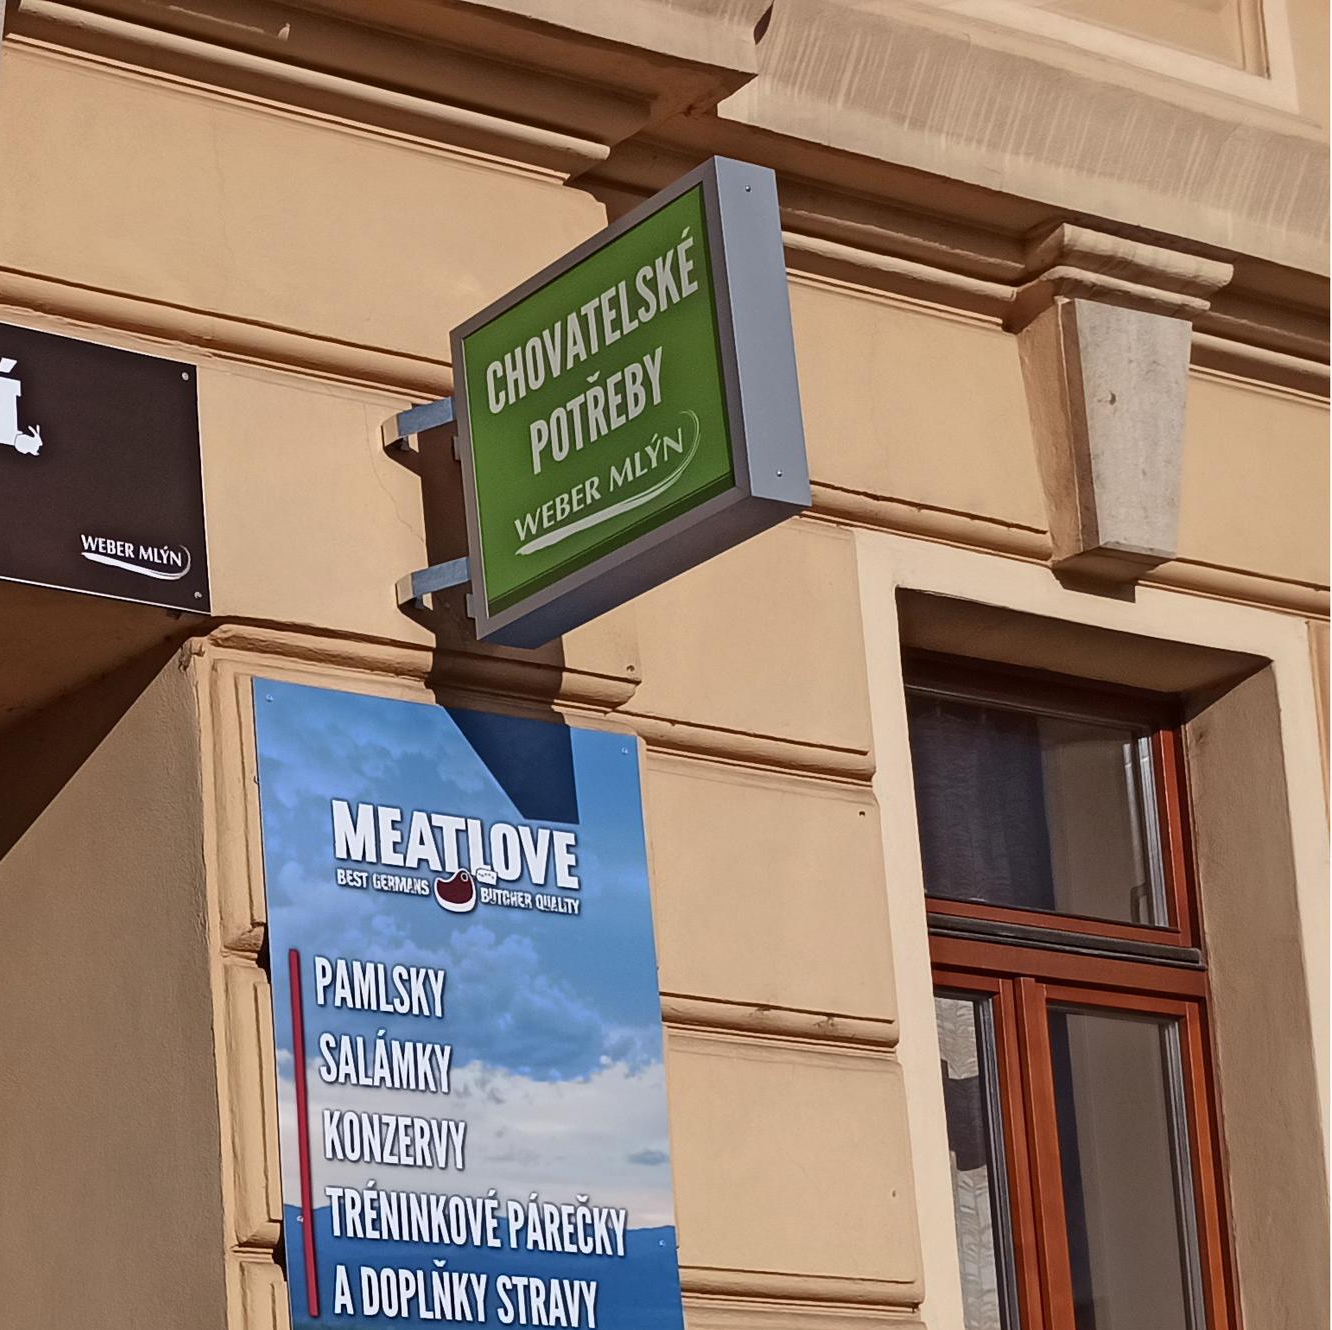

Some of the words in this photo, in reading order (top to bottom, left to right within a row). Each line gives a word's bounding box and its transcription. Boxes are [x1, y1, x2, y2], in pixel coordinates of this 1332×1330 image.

[486, 226, 699, 414] CHOVATELSKÉ
[530, 346, 663, 476] POTŘEBY
[514, 476, 602, 541] WEBER
[609, 427, 683, 492] MLÝN
[81, 534, 134, 558] WEBER
[139, 545, 182, 567] MLÝN
[332, 799, 579, 890] MEATLOVE
[337, 868, 369, 888] BEST
[372, 873, 430, 896] GERMANS
[480, 887, 533, 909] BUTCHER
[535, 894, 579, 915] QUALITY
[313, 955, 447, 1018] PAMLSKY
[318, 1029, 453, 1094] SALÁMKY
[323, 1109, 467, 1170] KONZERVY
[325, 1180, 501, 1248] TRÉNINKOVÉ
[507, 1192, 627, 1257] PÁREČKY
[334, 1264, 354, 1315] A
[361, 1259, 487, 1323] DOPLŇKY
[496, 1274, 597, 1329] STRAVY
